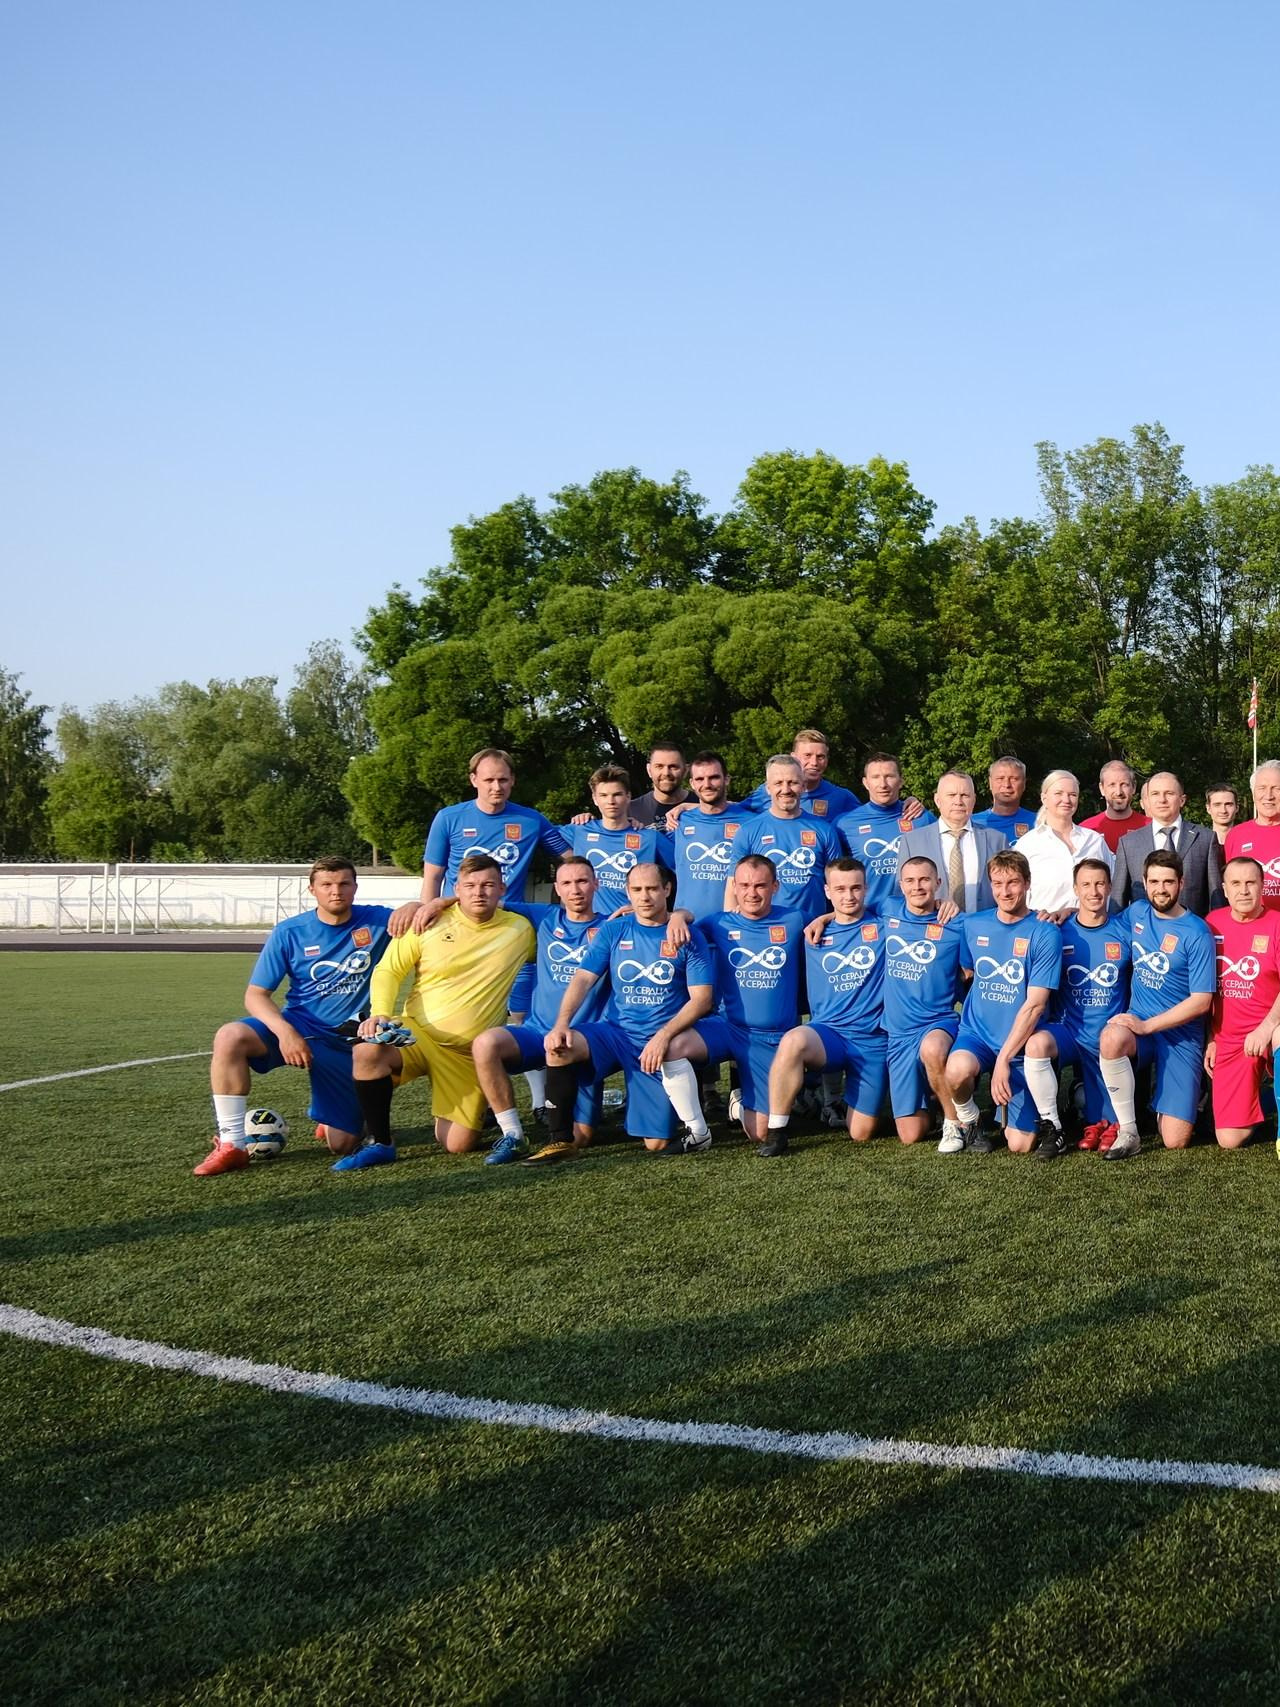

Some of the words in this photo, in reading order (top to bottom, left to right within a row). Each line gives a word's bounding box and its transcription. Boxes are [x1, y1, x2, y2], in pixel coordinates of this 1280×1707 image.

[871, 859, 881, 867] ОТ
[883, 858, 898, 866] СЕР
[702, 864, 730, 872] СЕРДЦА
[875, 868, 880, 876] К
[601, 871, 626, 881] СЕРДЦ
[692, 872, 697, 880] К
[698, 872, 728, 881] СЕРДЦУ
[550, 964, 560, 972] ОТ
[897, 961, 928, 973] СЕРДЦА
[735, 970, 746, 978] ОТ
[749, 970, 782, 979] СЕРДЦА
[893, 970, 922, 982] СЕРДЦУ
[829, 975, 839, 984] ОТ
[746, 980, 779, 989] СЕРДЦУ
[834, 985, 839, 993] К
[991, 982, 1020, 994] СЕРДЦА
[1225, 980, 1255, 989] СЕРДЦА
[622, 986, 634, 994] ОТ
[636, 986, 669, 995] СЕРДЦА
[1072, 989, 1082, 997] ОТ
[1084, 988, 1113, 998] СЕРДЦА
[1224, 990, 1252, 999] СЕРДЦУ
[626, 996, 631, 1004] К
[631, 996, 665, 1005] СЕРДЦУ
[988, 992, 1016, 1004] СЕРДЦУ
[1075, 998, 1080, 1006] К
[1081, 997, 1111, 1007] СЕРДЦУ
